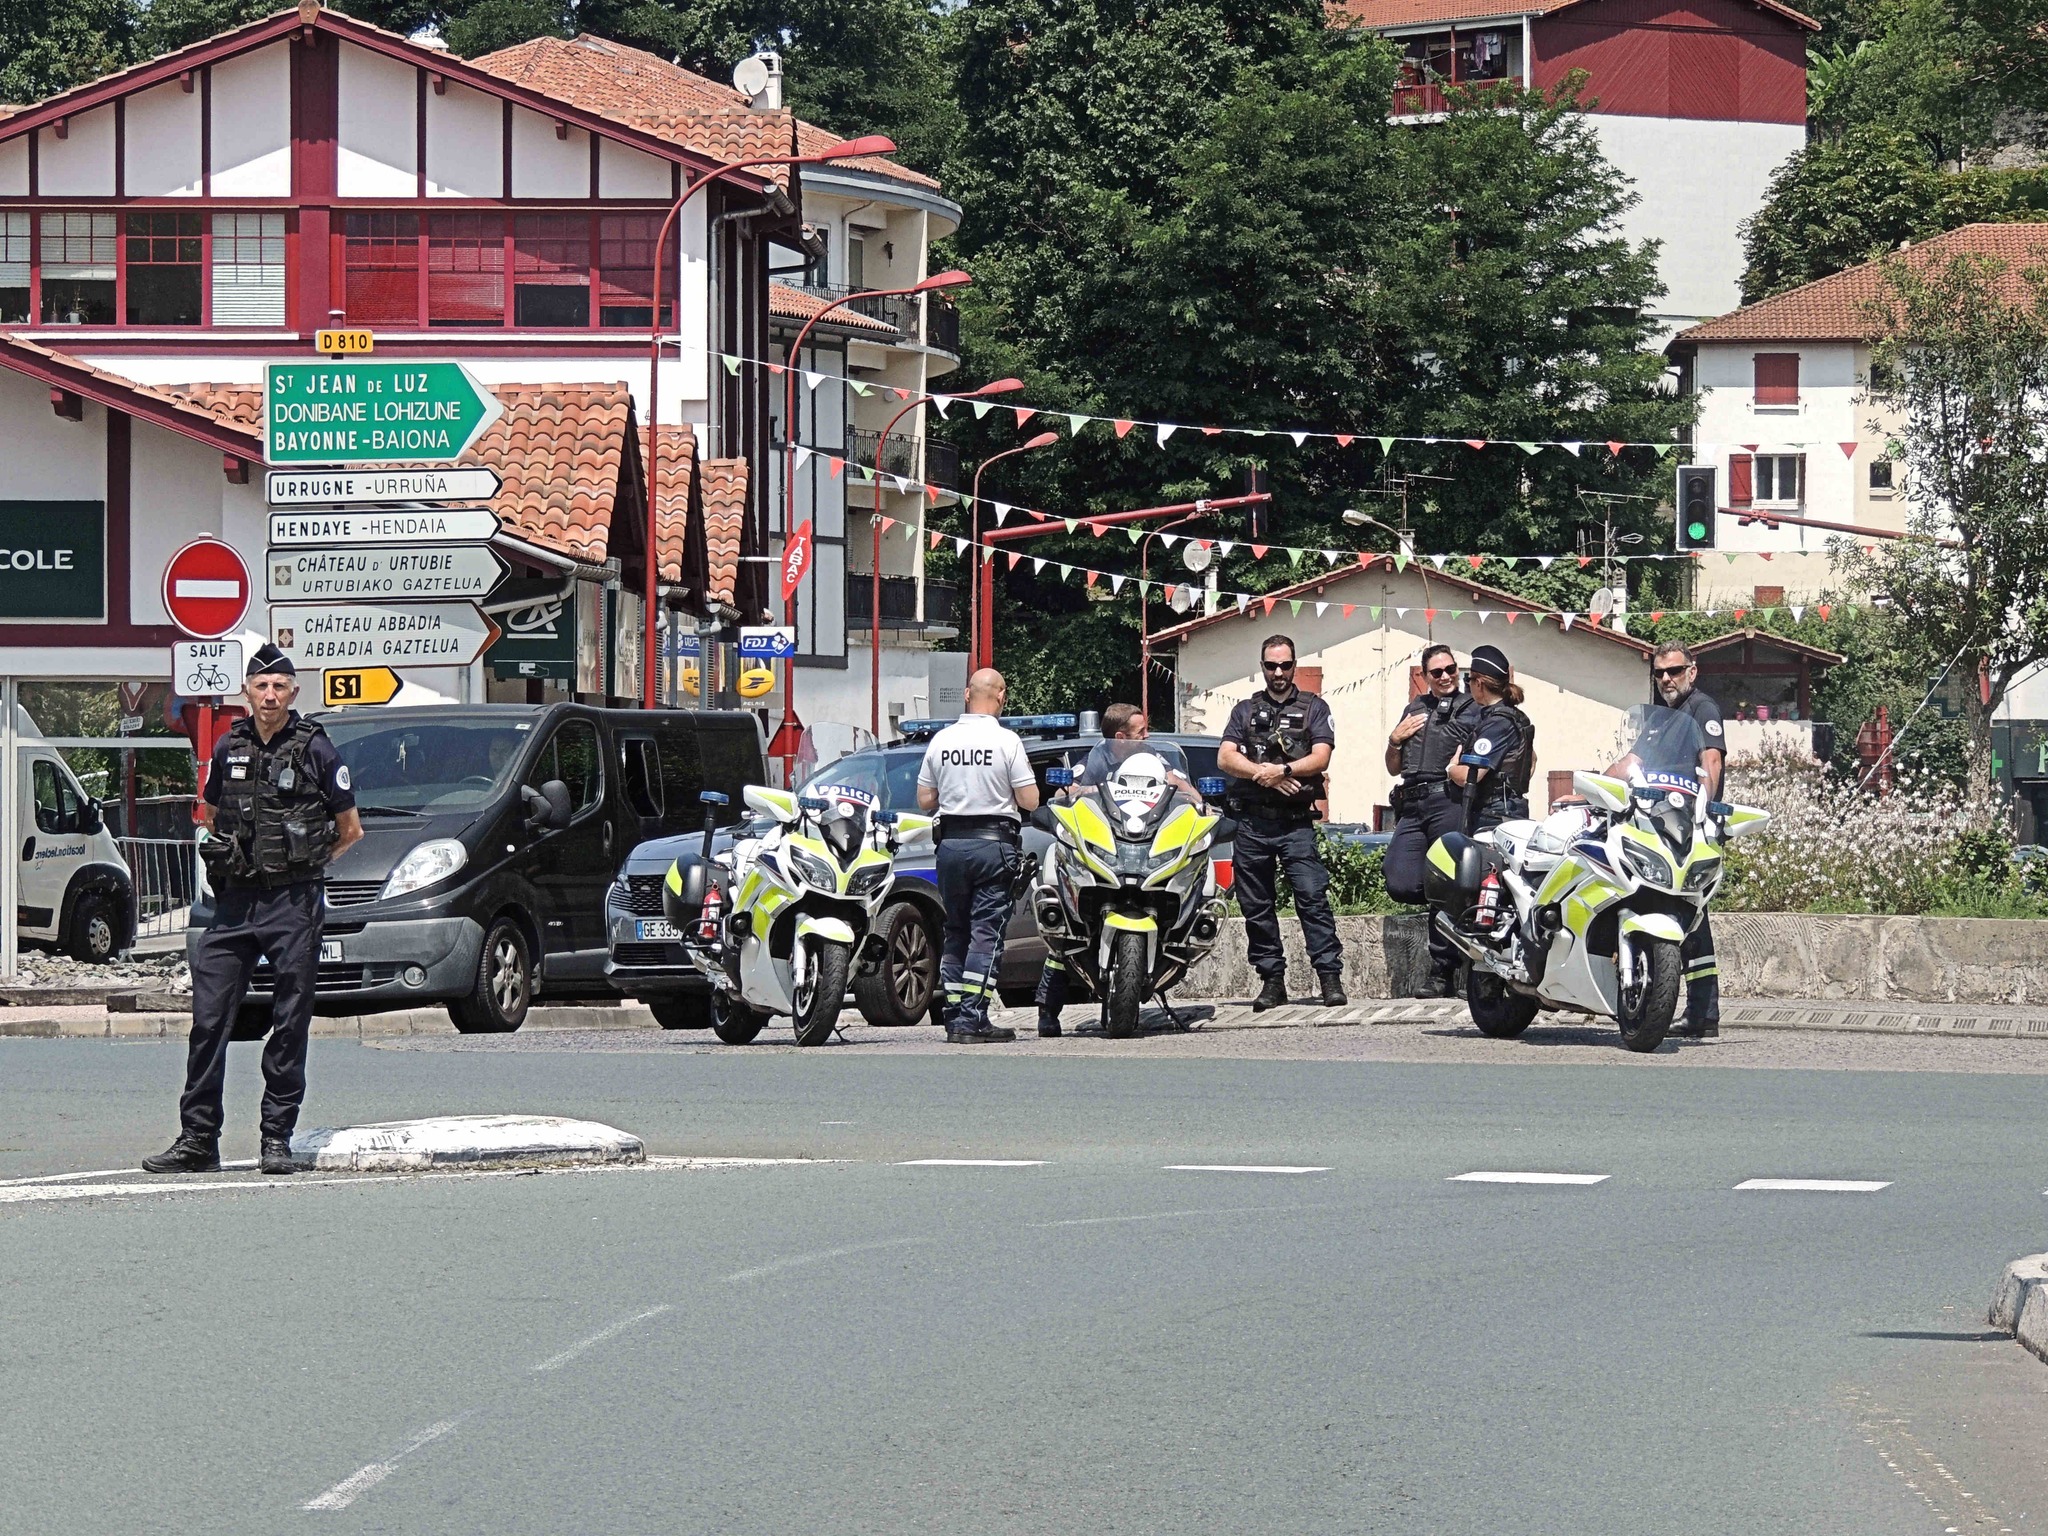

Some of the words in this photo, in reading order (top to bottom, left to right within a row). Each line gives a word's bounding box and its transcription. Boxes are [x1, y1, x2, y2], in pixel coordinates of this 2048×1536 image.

[324, 335, 332, 349] D
[338, 334, 368, 349] 810
[306, 374, 356, 393] JEAN
[394, 373, 428, 393] LUZ
[275, 402, 367, 423] DONIBANE
[374, 401, 461, 422] LOHIZUNE
[276, 480, 354, 496] URRUGNE
[277, 520, 351, 537] HENDAYE
[0, 549, 74, 571] COLE
[297, 554, 367, 572] CHÂTEAU
[389, 555, 453, 571] URTUBIE
[786, 536, 807, 583] TABAC
[302, 578, 393, 593] URTUBIAKO
[403, 577, 482, 591] GAZTELUA
[304, 614, 372, 633] CHÂTEAU
[378, 615, 441, 632] ABBADIA
[190, 644, 226, 658] SAUF
[305, 641, 373, 657] ABBADIA
[383, 638, 459, 655] GAZTELUA
[744, 637, 768, 648] FDJ
[334, 678, 357, 697] S1
[941, 749, 993, 767] POLICE
[1647, 773, 1698, 792] POLICE
[819, 785, 871, 802] POLICE
